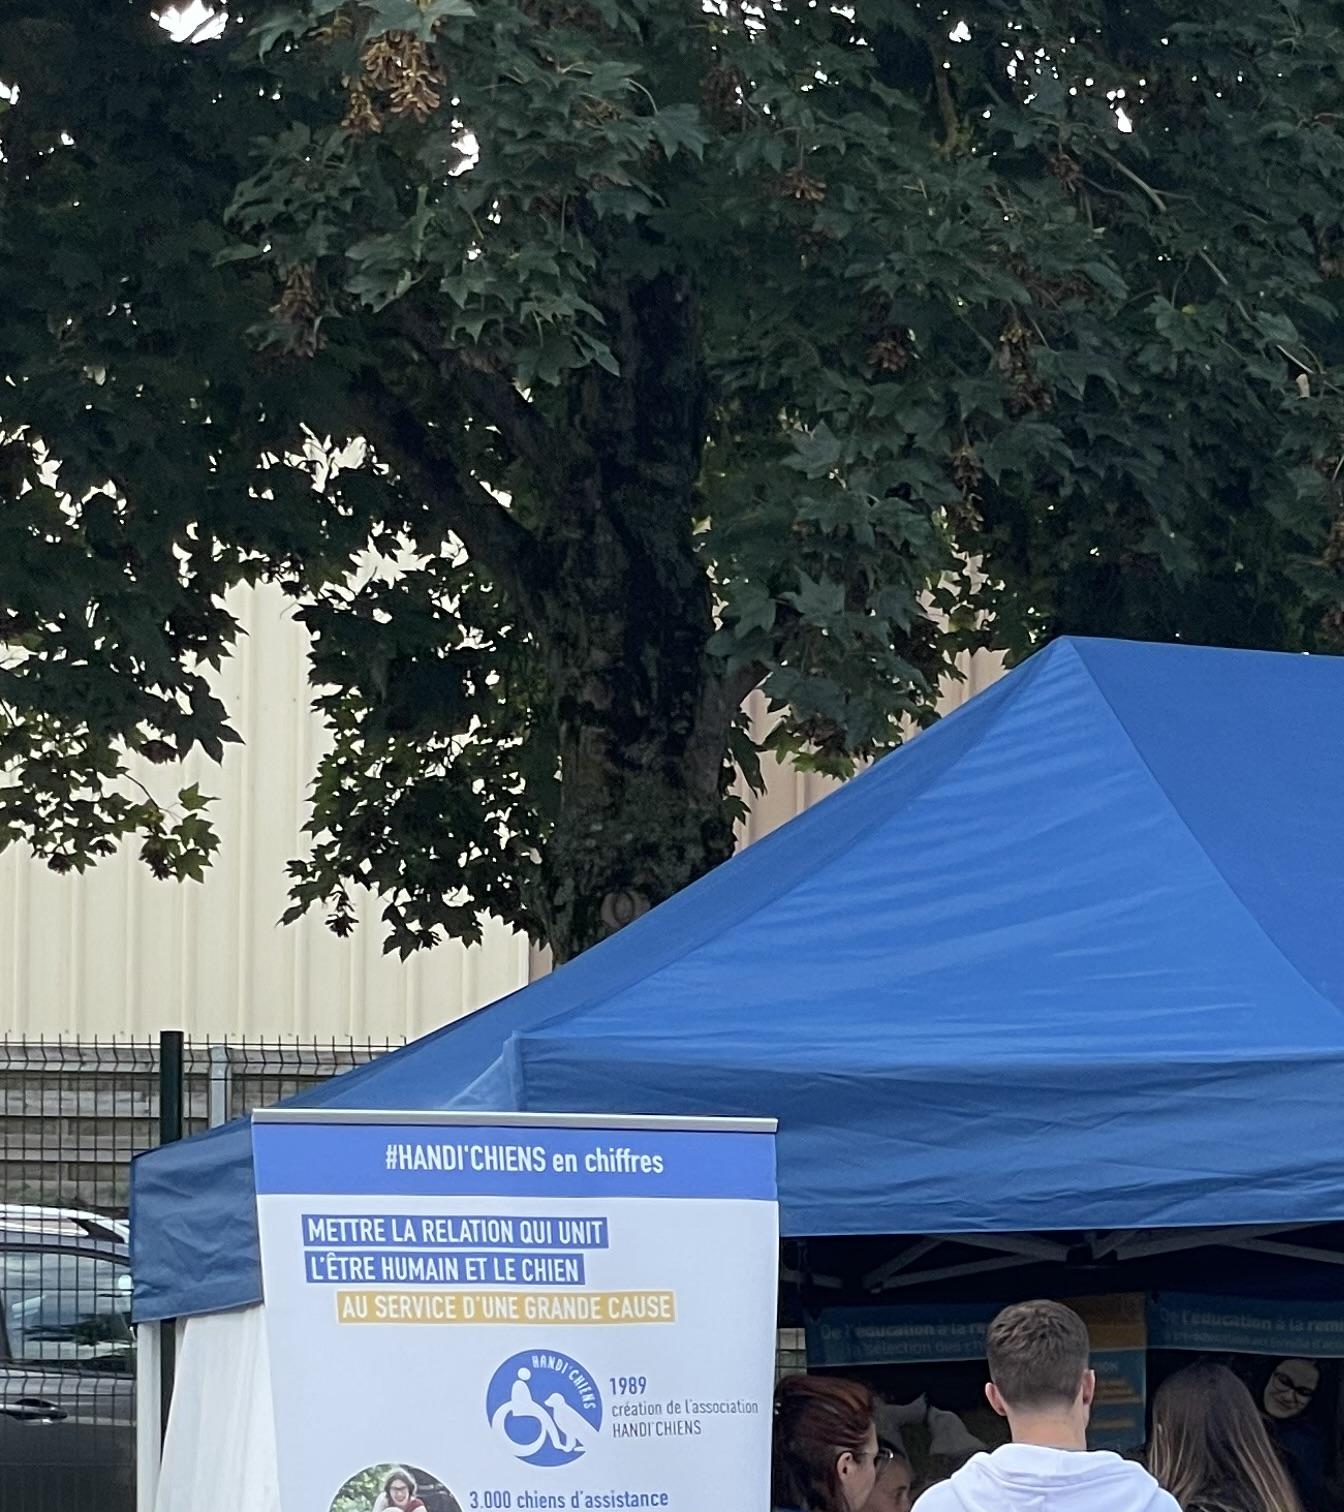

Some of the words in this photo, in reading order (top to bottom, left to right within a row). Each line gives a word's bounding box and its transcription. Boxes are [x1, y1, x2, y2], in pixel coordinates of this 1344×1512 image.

[385, 1144, 546, 1171] #HANDI'CHIENS
[552, 1153, 577, 1172] en
[584, 1147, 663, 1173] chiffres
[308, 1218, 386, 1243] METTRE
[391, 1218, 416, 1243] LA
[421, 1219, 514, 1242] RELATION
[519, 1220, 552, 1244] QUI
[558, 1220, 602, 1244] UNIT
[311, 1252, 376, 1283] L'ÊTRE
[381, 1257, 458, 1284] HUMAIN
[464, 1257, 487, 1282] ET
[493, 1257, 516, 1285] LE
[521, 1258, 578, 1282] CHIEN
[342, 1295, 368, 1318] AU
[374, 1295, 456, 1318] SERVICE
[462, 1296, 519, 1319] D'UNE
[524, 1296, 602, 1319] GRANDE
[607, 1296, 672, 1319] CAUSE
[532, 1354, 597, 1411] HANDI'CHIENS
[609, 1376, 646, 1395] 1989
[611, 1401, 662, 1417] création
[666, 1399, 681, 1414] de
[684, 1399, 758, 1414] l'association
[612, 1420, 701, 1437] HANDI'CHIENS
[516, 1490, 565, 1508] chiens
[570, 1490, 668, 1508] d'assistance
